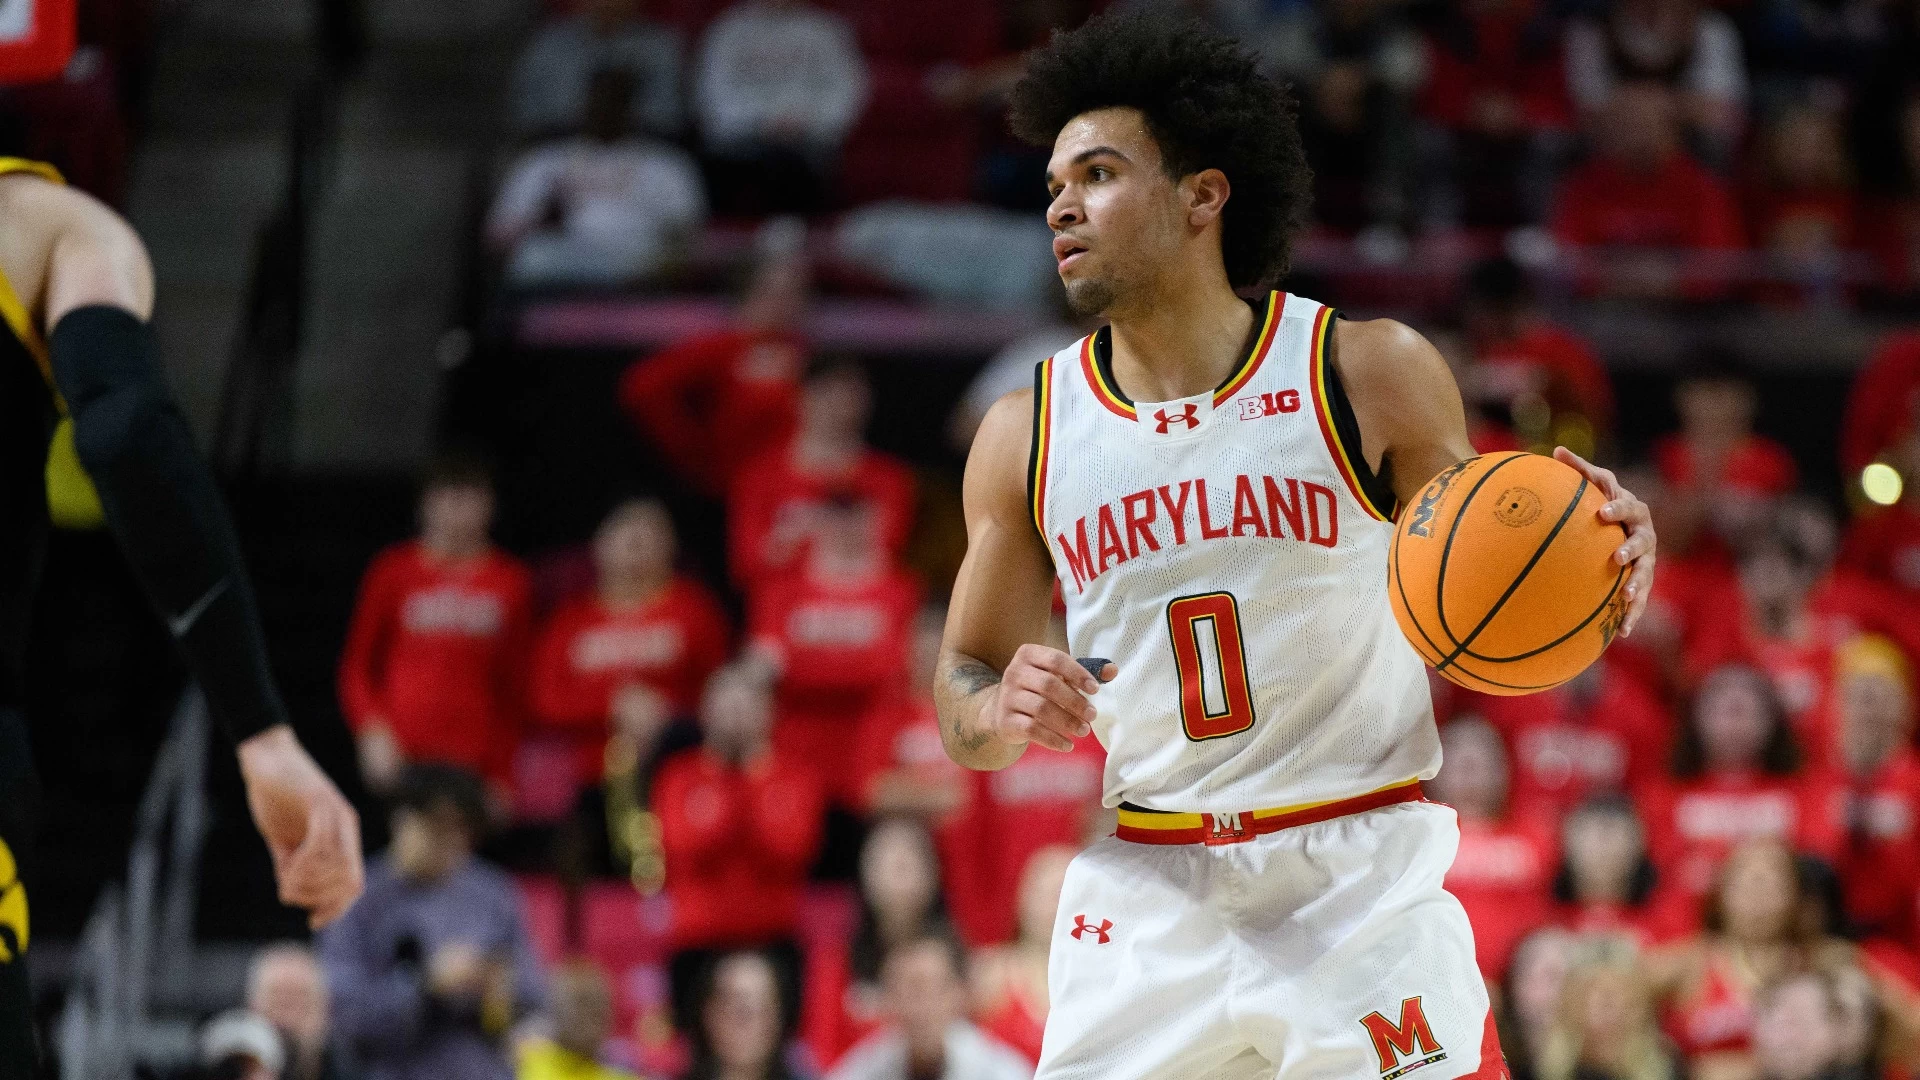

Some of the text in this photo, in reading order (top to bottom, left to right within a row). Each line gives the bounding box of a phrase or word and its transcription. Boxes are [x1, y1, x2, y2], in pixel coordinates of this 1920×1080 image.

[1057, 474, 1338, 594] MARYLAND
[1166, 590, 1256, 742] 0
[1210, 812, 1244, 833] M
[1359, 995, 1443, 1074] M
